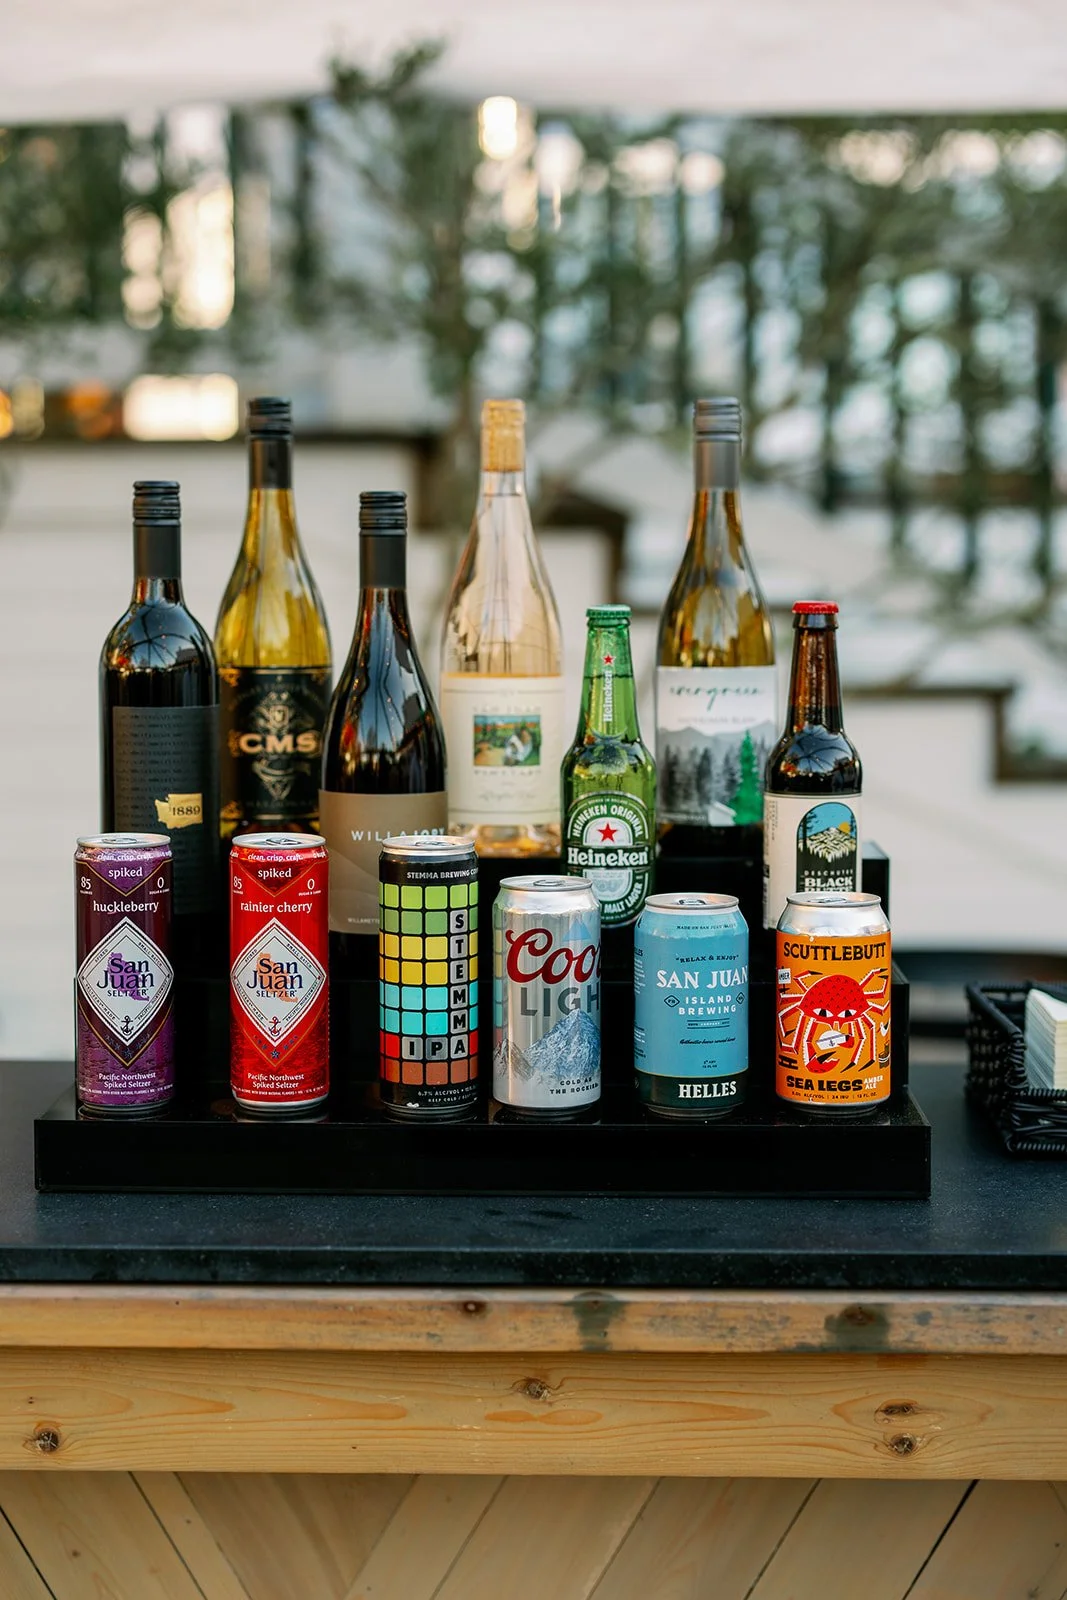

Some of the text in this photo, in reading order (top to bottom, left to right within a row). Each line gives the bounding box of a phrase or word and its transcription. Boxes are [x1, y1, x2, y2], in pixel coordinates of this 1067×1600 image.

[603, 670, 613, 722] Heineken
[240, 733, 317, 754] CMS
[172, 806, 201, 816] 1889
[572, 804, 644, 837] HEINEKEN ORIGINAL
[567, 847, 648, 866] Heineken
[108, 867, 143, 879] spiked
[258, 868, 292, 880] spiked
[440, 869, 470, 879] BREWING
[81, 876, 91, 890] 85
[157, 876, 165, 889] 0
[233, 876, 243, 890] 85
[307, 878, 315, 890] 0
[805, 876, 853, 888] BLACK
[604, 882, 643, 914] MALT LAGER
[93, 900, 159, 913] huckleberry
[240, 901, 313, 914] rainier cherry
[505, 928, 600, 985] Coo
[784, 941, 886, 961] SCUTTLEBUTT
[110, 957, 150, 974] San
[259, 958, 299, 974] San
[96, 970, 155, 989] Juan
[246, 970, 304, 990] Juan
[656, 969, 700, 989] SAN
[706, 965, 748, 989] JUAN
[107, 989, 147, 997] SELTZER
[256, 990, 296, 998] SELTZER
[685, 994, 732, 1005] ISLAND
[678, 1005, 736, 1015] BREWING
[409, 1039, 466, 1056] IPA
[98, 1072, 156, 1081] Pacific Northwest
[247, 1073, 305, 1081] Pacific Northwest
[864, 1075, 883, 1084] AMBER
[104, 1081, 127, 1089] Spiked
[128, 1080, 151, 1088] Seltzer
[252, 1081, 275, 1089] Spiked
[275, 1081, 299, 1089] Seltzer
[678, 1080, 737, 1098] HELLES
[786, 1075, 863, 1092] SEA LEGS
